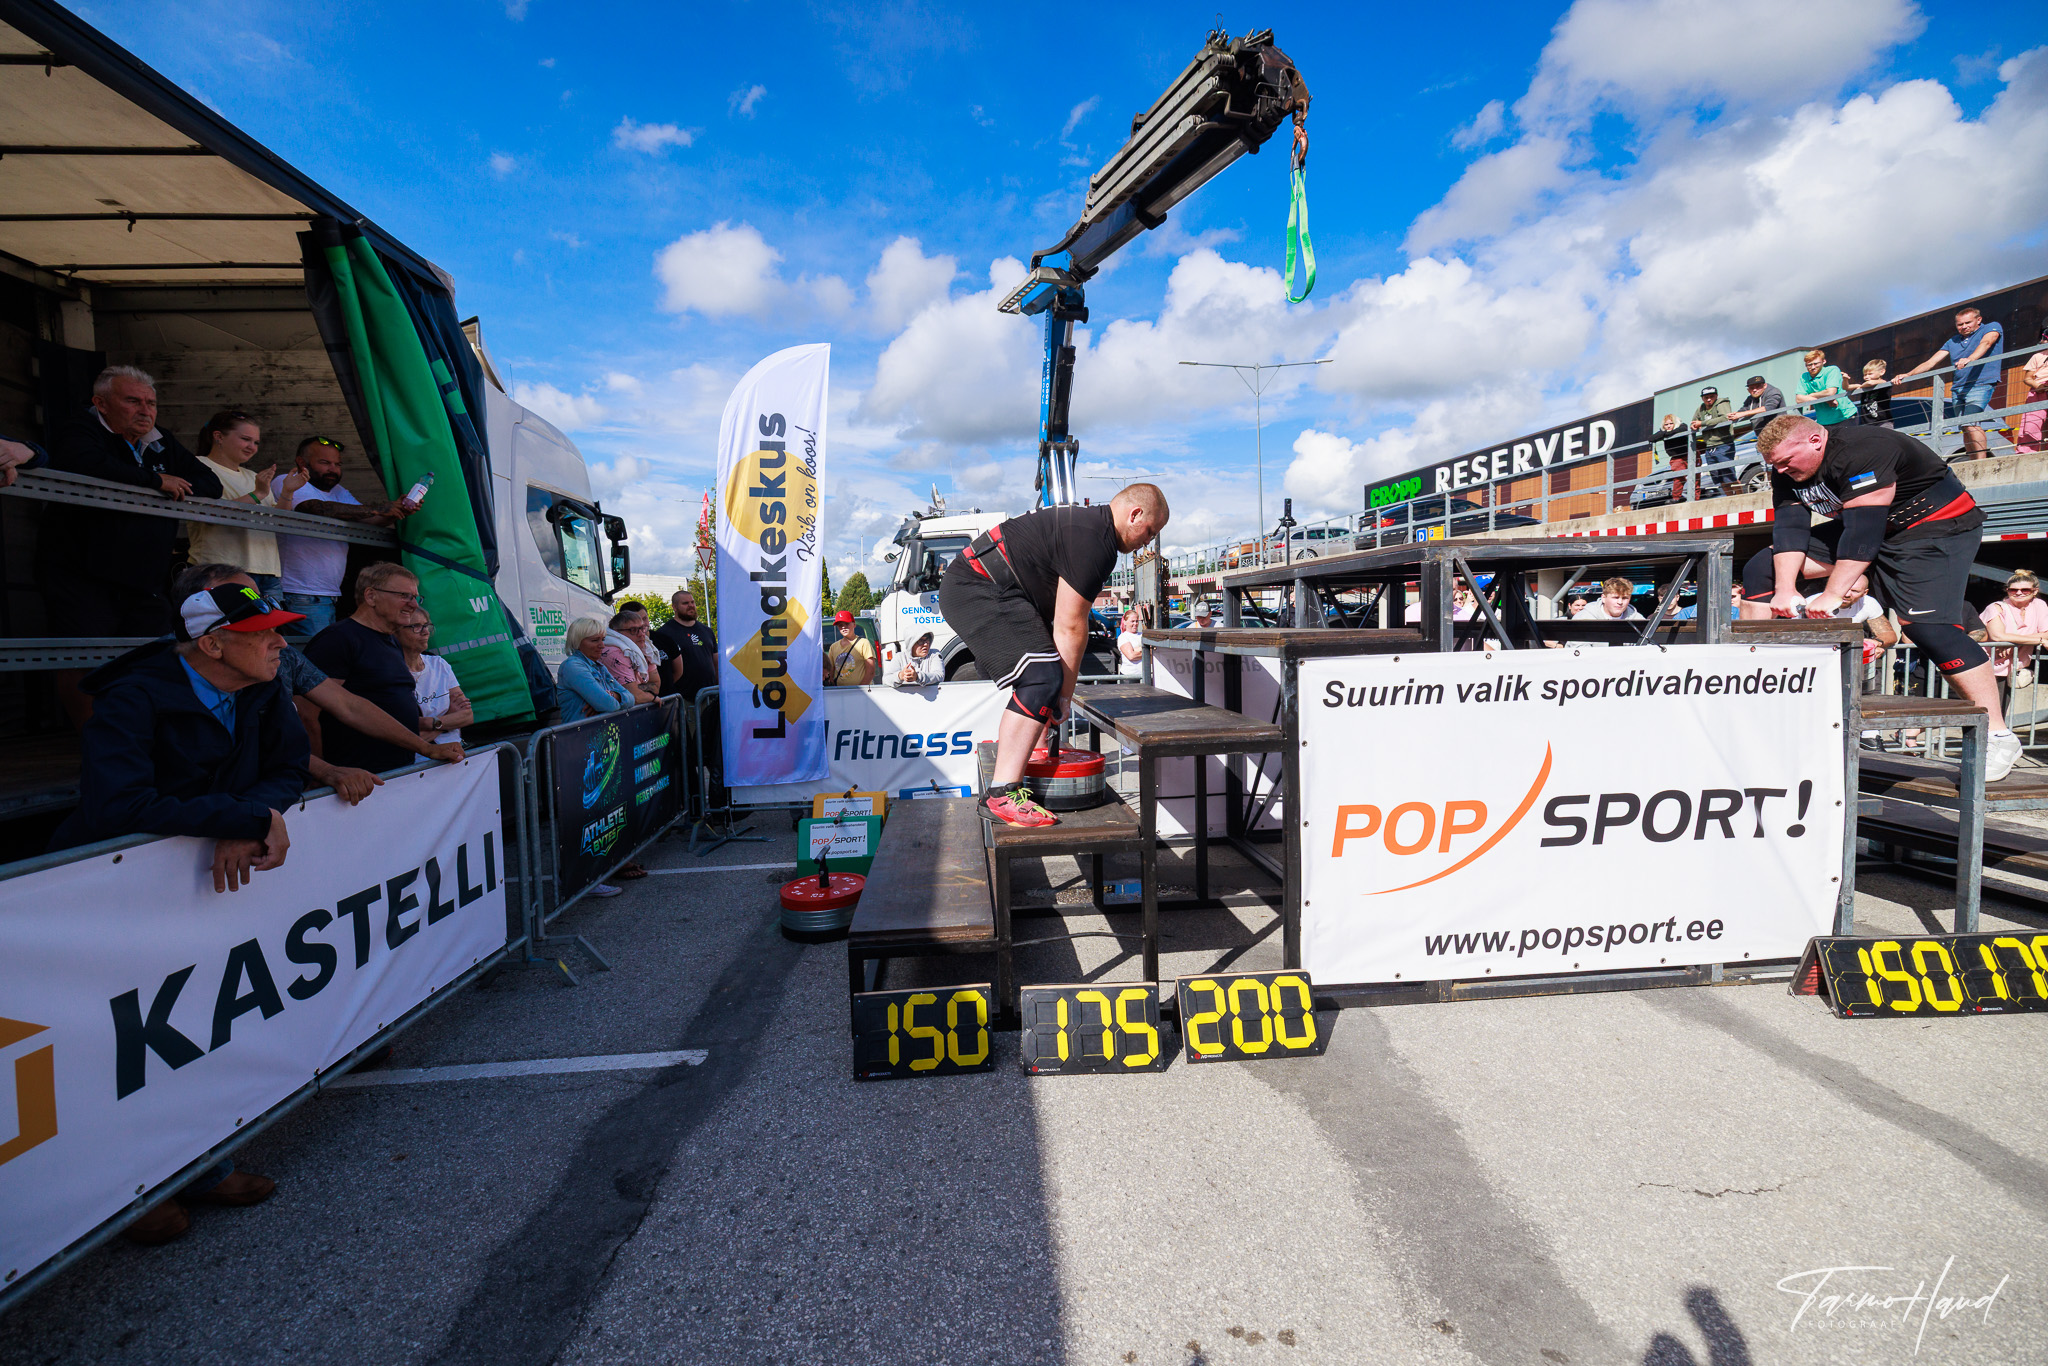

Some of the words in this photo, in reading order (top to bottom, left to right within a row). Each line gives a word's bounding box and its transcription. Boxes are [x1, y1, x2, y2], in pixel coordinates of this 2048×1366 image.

[794, 425, 817, 479] koos!
[1435, 419, 1616, 494] RESERVED
[804, 483, 817, 508] on
[1370, 476, 1422, 508] CROPP
[796, 513, 816, 562] Kõik
[749, 412, 788, 738] Lõunakeskus
[901, 606, 932, 615] GENNO
[1322, 679, 1444, 708] Suurim
[1456, 674, 1531, 702] valik
[1540, 667, 1817, 709] spordivahendeid!
[633, 732, 670, 761] ENGINEERING
[834, 729, 973, 761] fitness
[634, 757, 661, 785] HUMAN
[583, 806, 625, 848] ATHLETE
[593, 827, 617, 851] BYTES
[1330, 800, 1488, 858] POP
[1540, 779, 1814, 848] SPORT!
[812, 838, 830, 846] POP
[834, 835, 866, 844] SPORT!
[1424, 915, 1724, 957] www.popsport.ee
[109, 830, 497, 1102] KASTELLI
[1857, 941, 1964, 1012] 150
[887, 990, 988, 1071] 150
[1057, 989, 1159, 1068] 175
[1187, 976, 1318, 1055] 200
